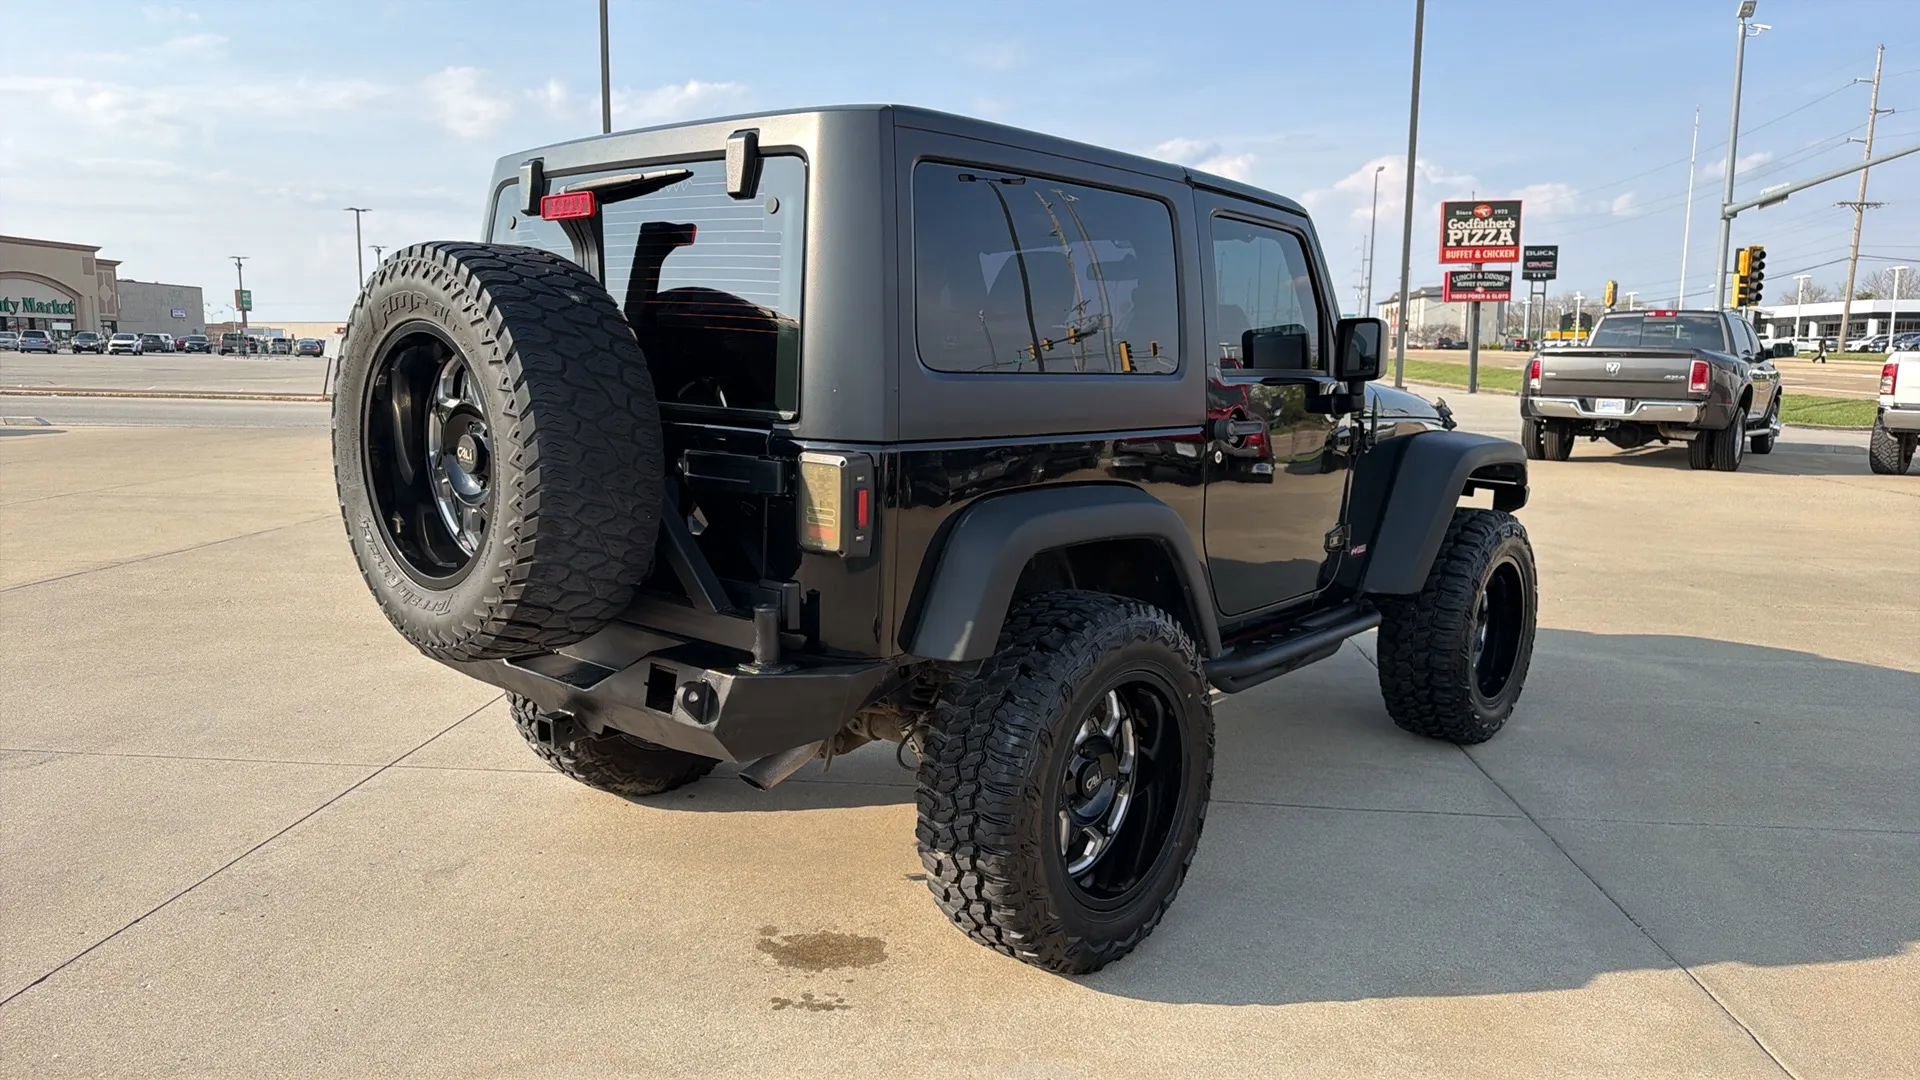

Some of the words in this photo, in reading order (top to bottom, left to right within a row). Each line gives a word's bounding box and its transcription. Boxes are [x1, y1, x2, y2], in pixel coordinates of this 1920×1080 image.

[1448, 217, 1516, 229] Godfather's
[1447, 228, 1515, 246] PIZZA
[1445, 250, 1473, 259] BUFFET
[1474, 249, 1482, 259] &
[1482, 249, 1516, 259] CHICKEN
[1452, 273, 1476, 283] LUNCH
[1484, 273, 1511, 283] DINNER
[21, 297, 75, 315] Market
